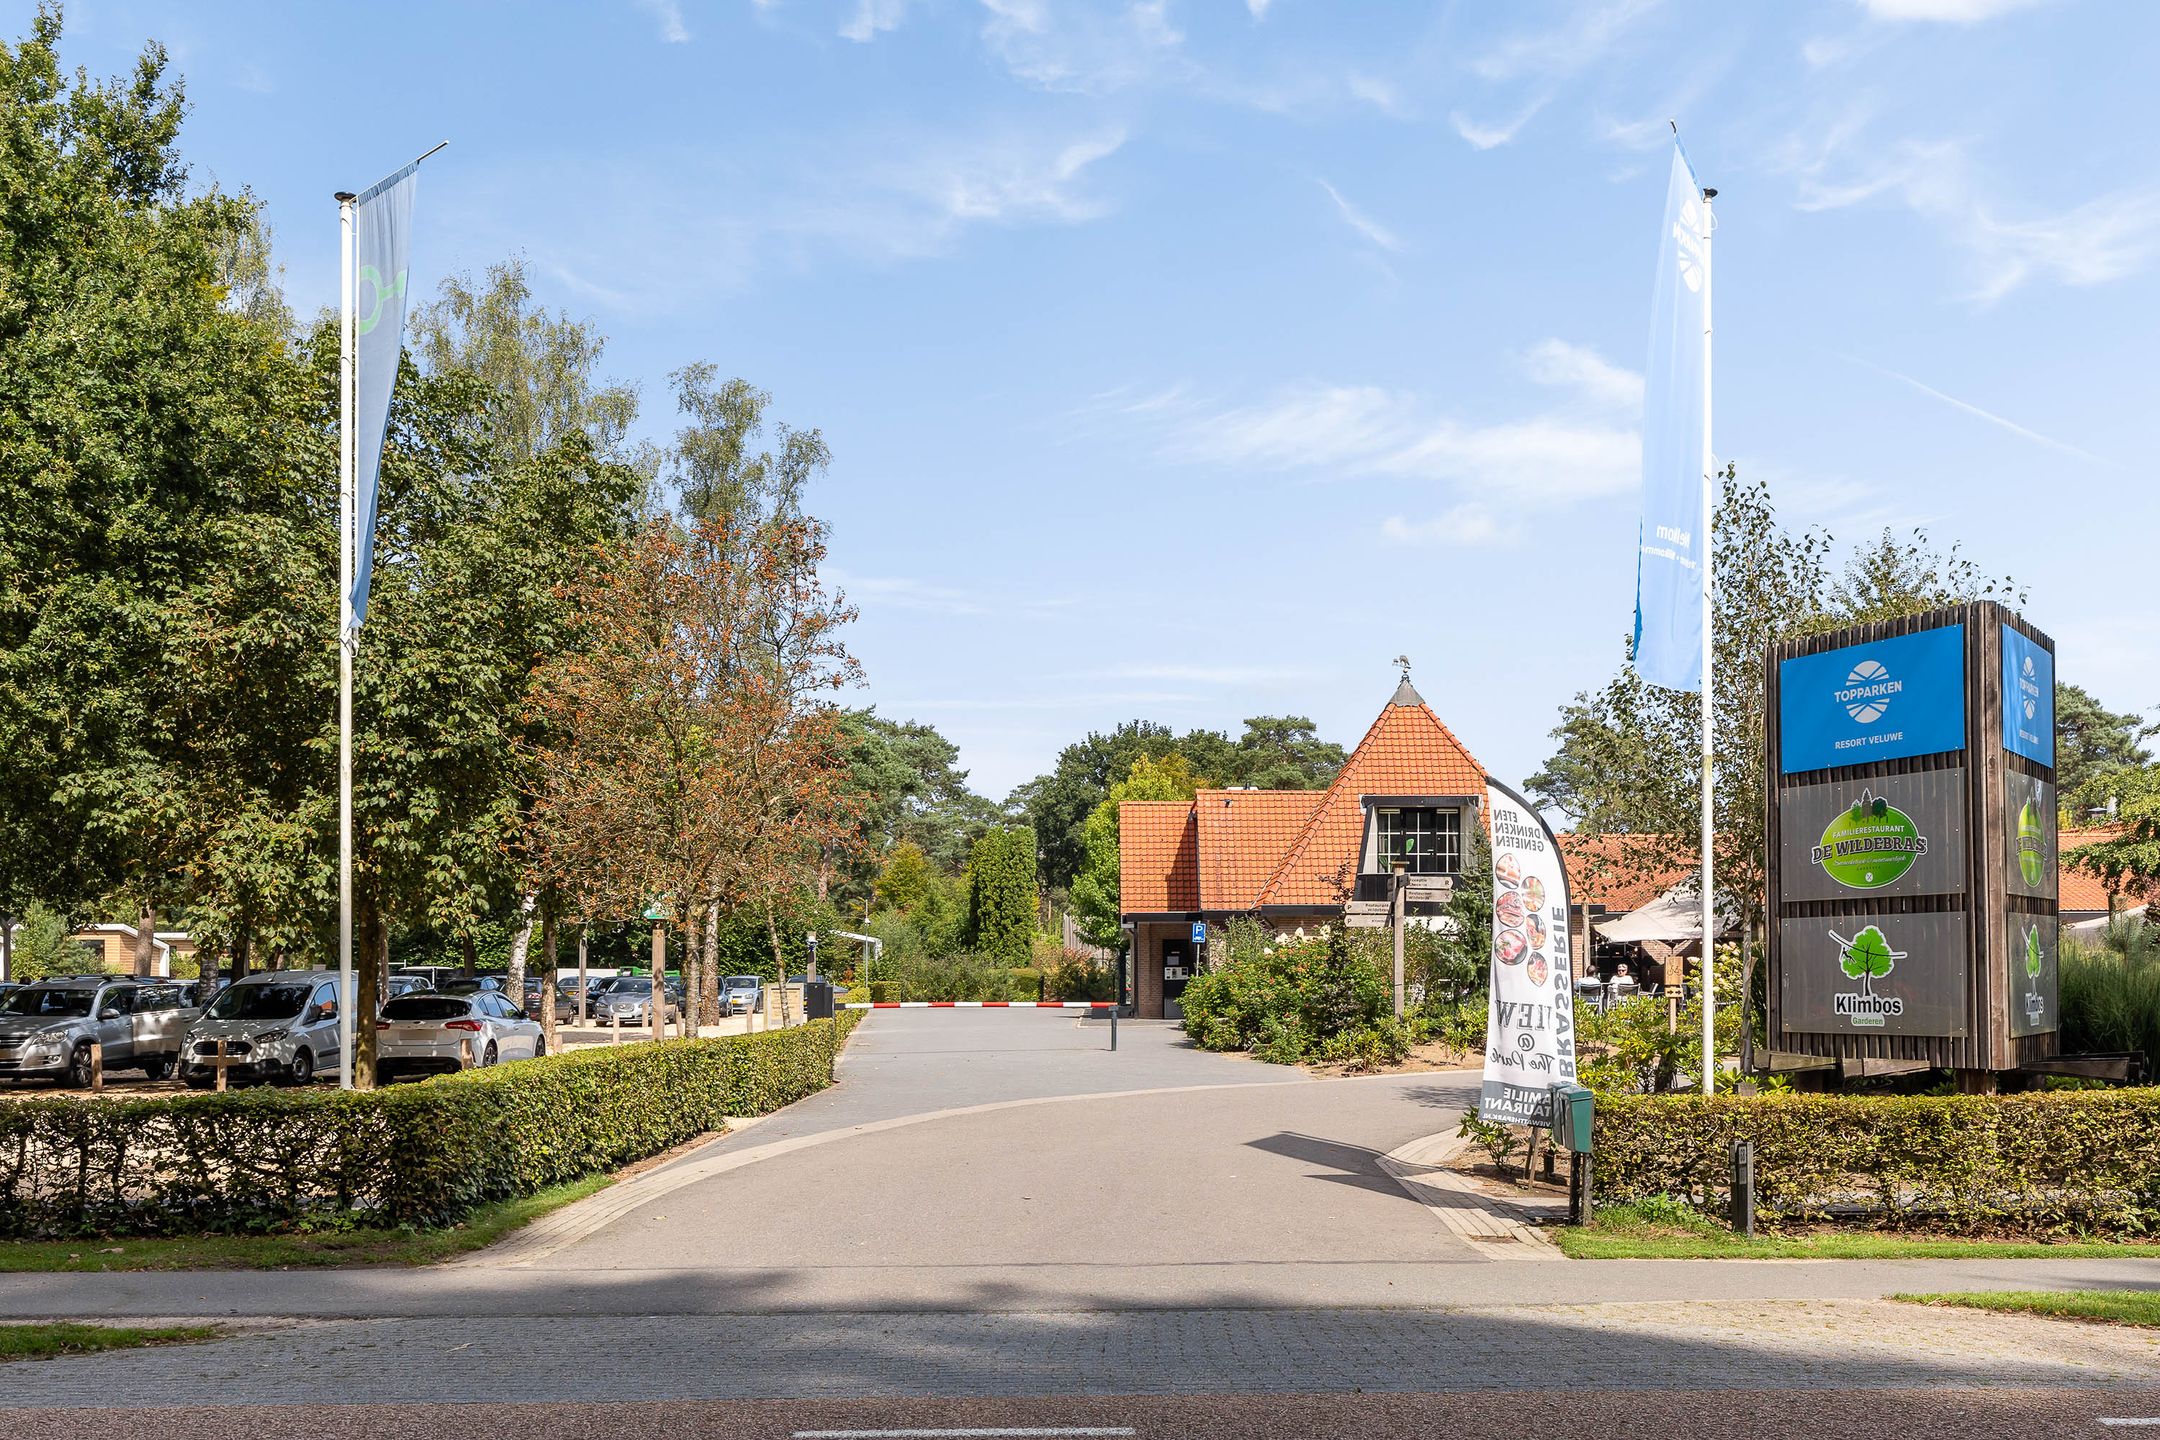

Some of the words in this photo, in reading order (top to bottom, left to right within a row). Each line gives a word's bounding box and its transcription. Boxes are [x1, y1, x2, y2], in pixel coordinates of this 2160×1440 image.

[1834, 680, 1902, 703] TOPPARKEN
[1835, 737, 1866, 749] RESORT
[1868, 731, 1903, 745] VELUWE
[1832, 825, 1905, 839] FAMILIERESTAURANT
[1812, 844, 1833, 862] DE
[1835, 836, 1927, 856] WILDEBRAS
[1195, 925, 1203, 935] P
[1836, 996, 1901, 1013] Klimbos
[1852, 1016, 1884, 1025] Garderen
